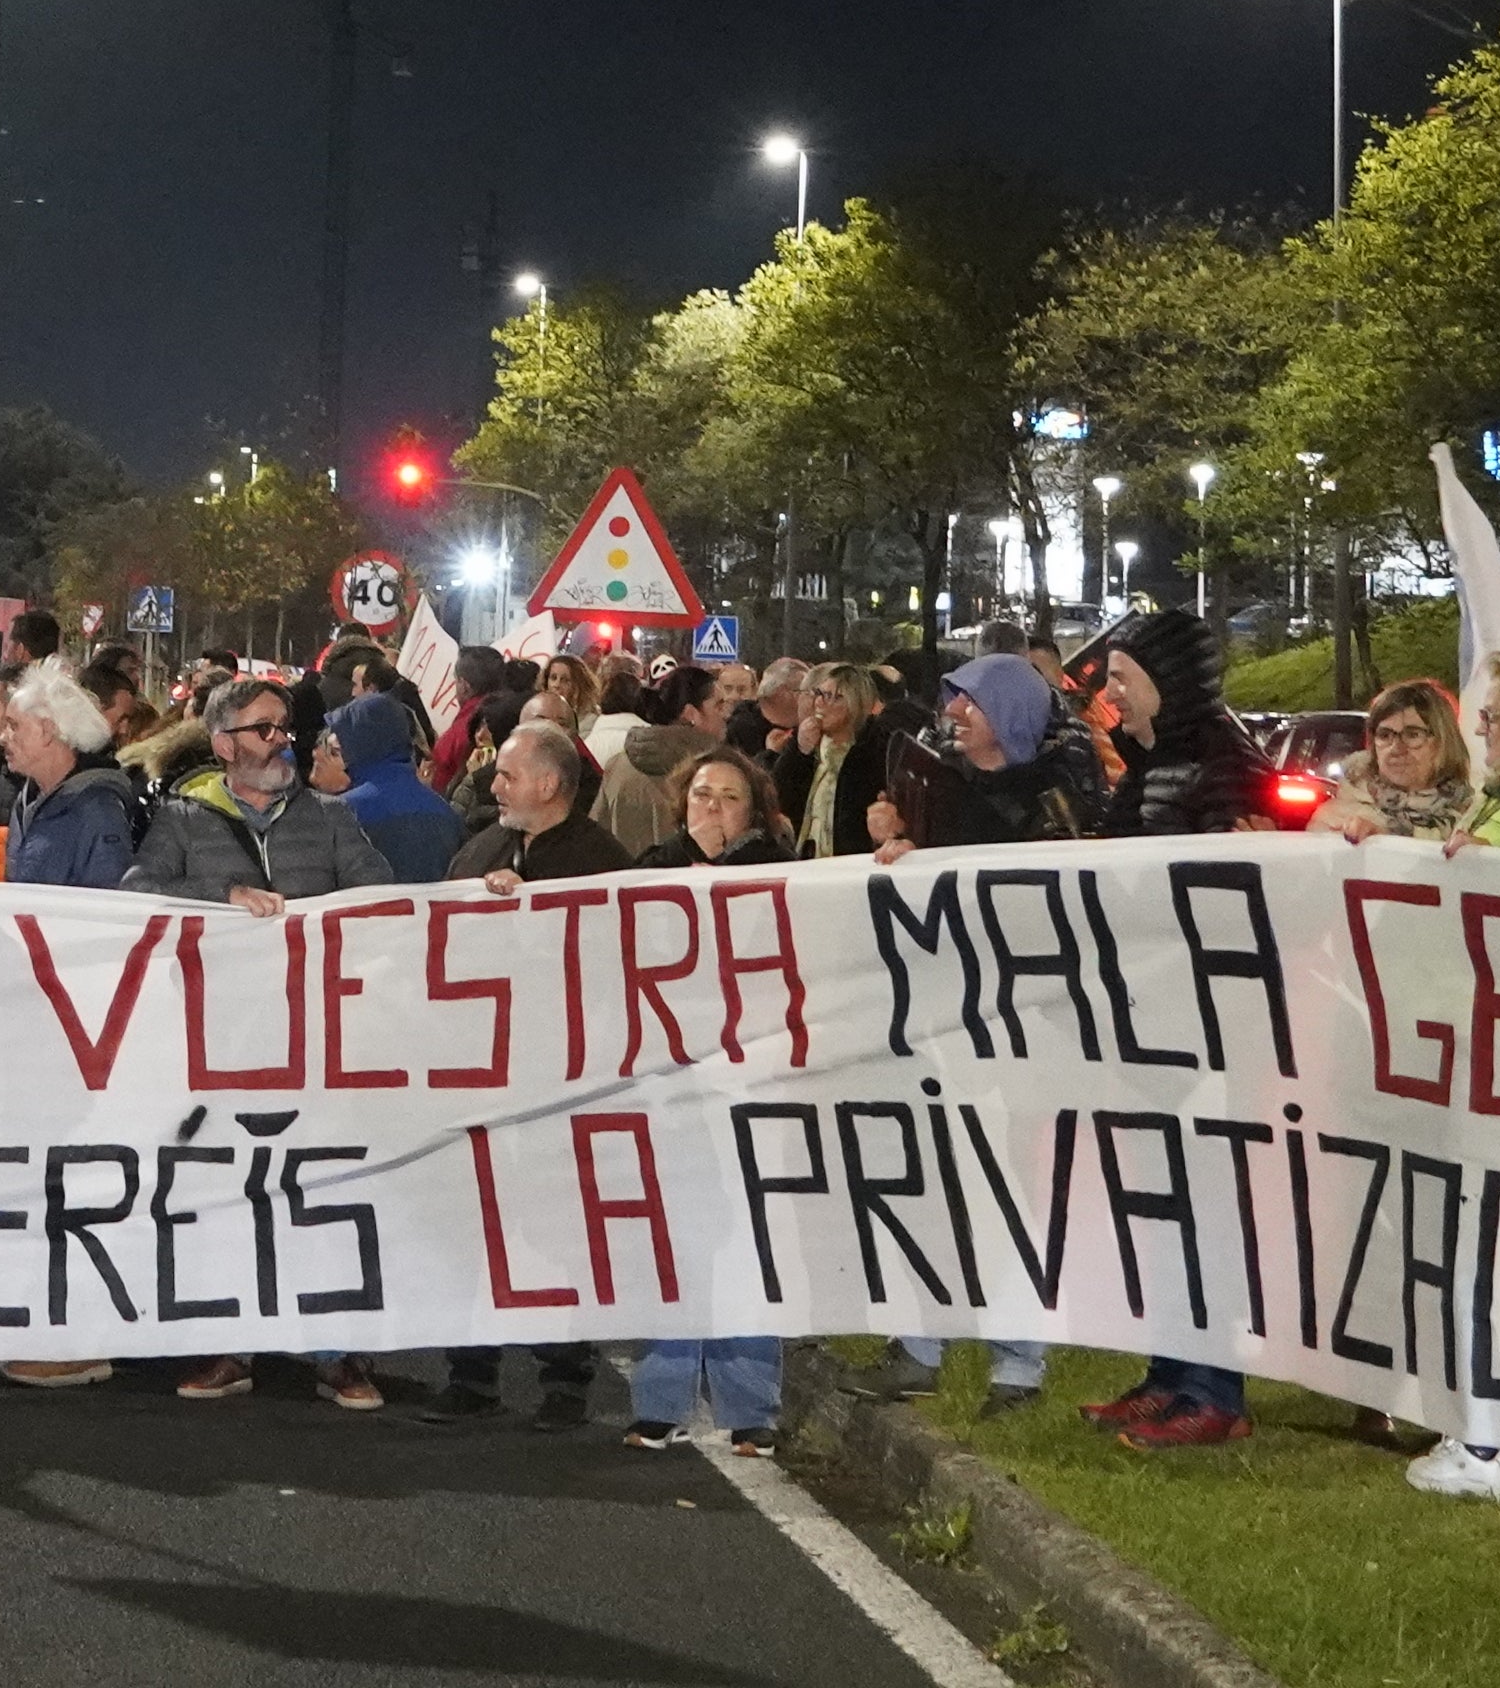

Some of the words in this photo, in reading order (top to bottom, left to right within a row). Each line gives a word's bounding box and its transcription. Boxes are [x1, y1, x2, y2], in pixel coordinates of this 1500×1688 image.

[351, 579, 400, 607] 40
[14, 878, 810, 1091] VUESTRA
[868, 861, 1299, 1080] MALA
[471, 1113, 679, 1309] LA
